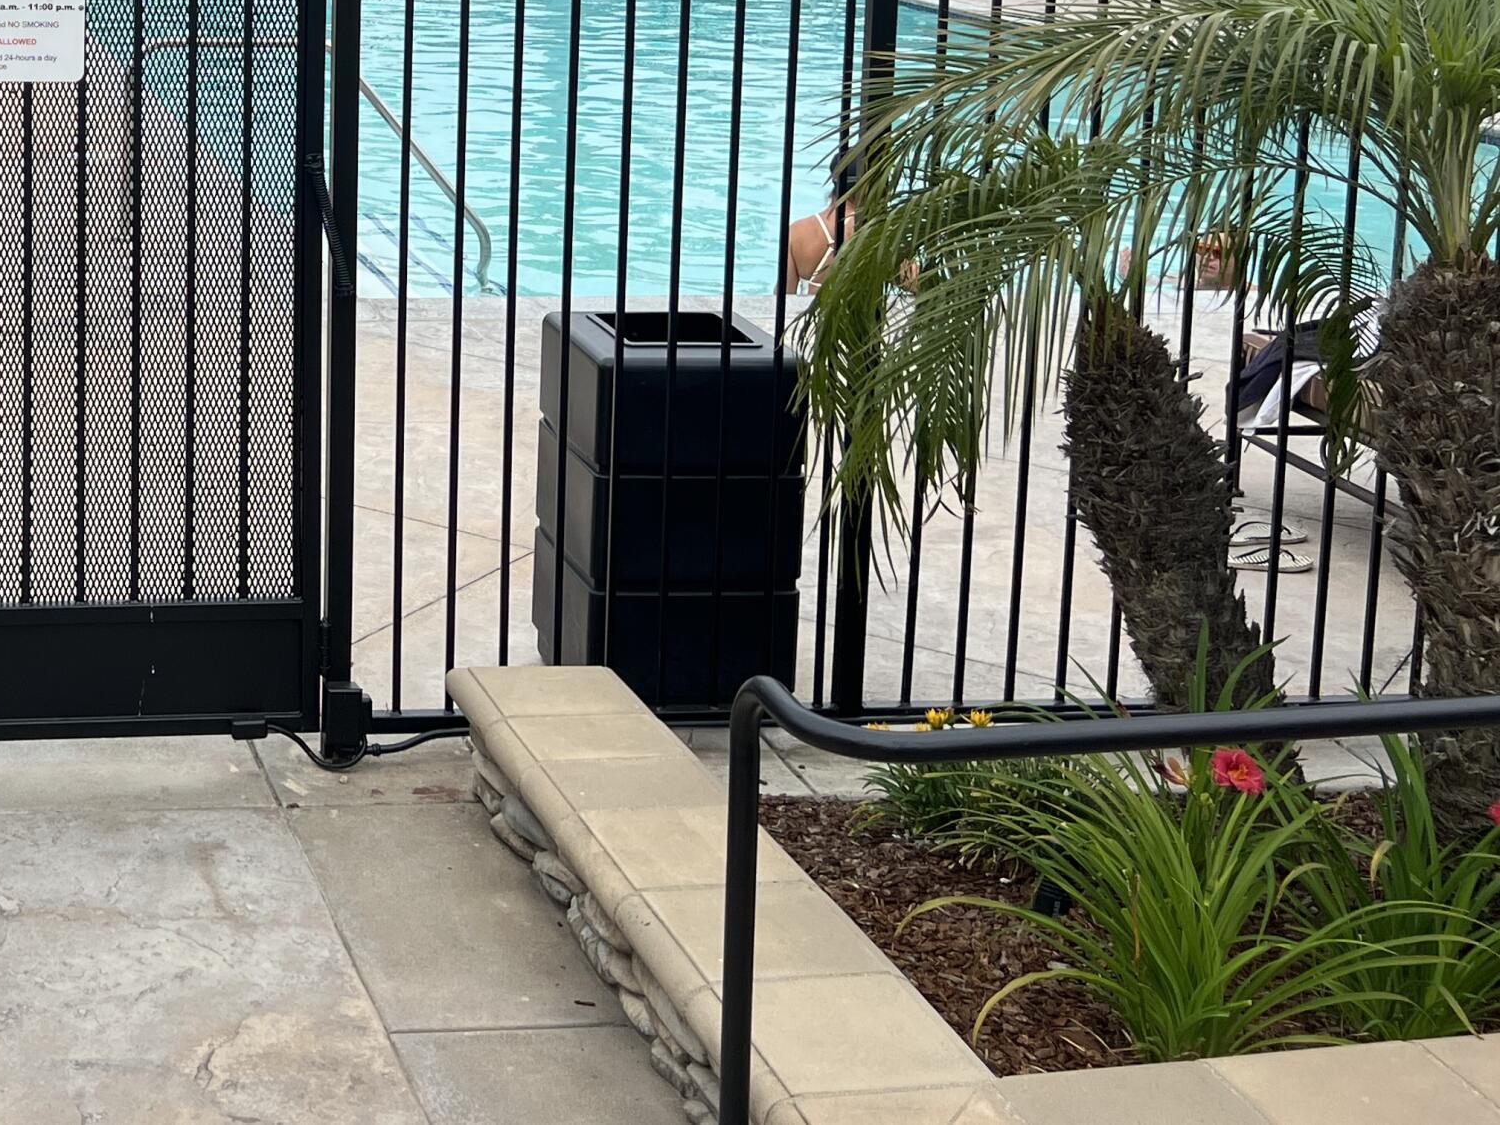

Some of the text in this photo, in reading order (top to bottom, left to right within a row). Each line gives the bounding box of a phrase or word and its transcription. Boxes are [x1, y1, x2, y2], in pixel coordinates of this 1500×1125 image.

[0, 3, 20, 11] a.m.
[28, 2, 54, 11] 11:00
[55, 4, 76, 12] p.m.
[8, 20, 20, 28] NO
[22, 20, 60, 29] SMOKING
[4, 54, 36, 62] 24-hours
[44, 54, 58, 63] day
